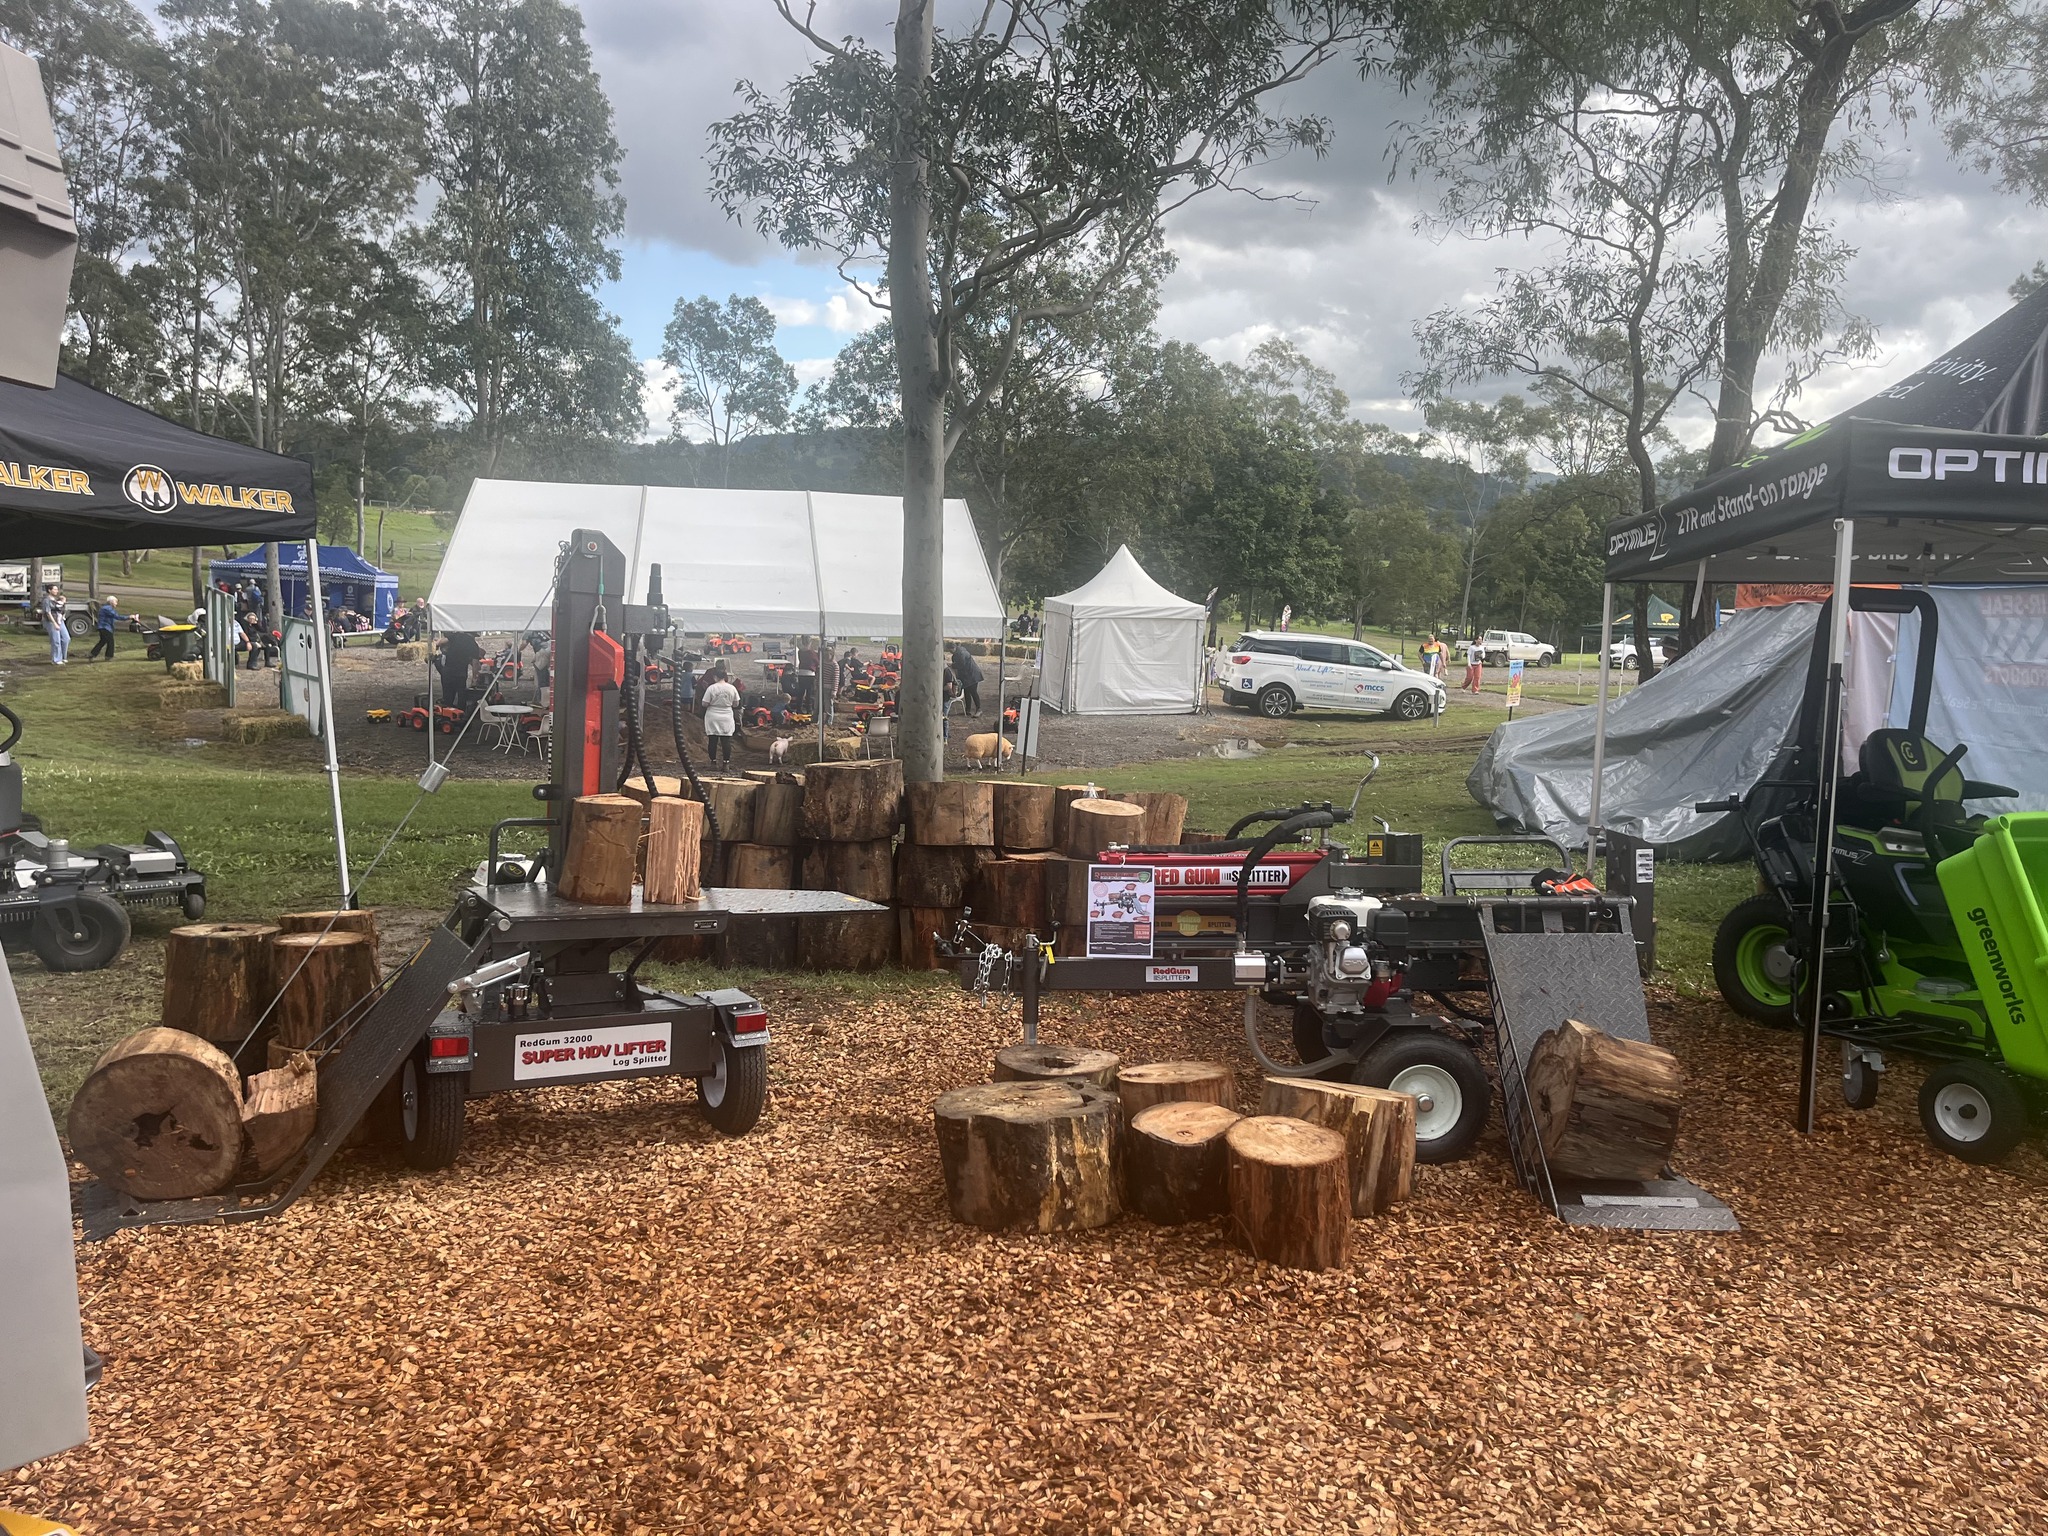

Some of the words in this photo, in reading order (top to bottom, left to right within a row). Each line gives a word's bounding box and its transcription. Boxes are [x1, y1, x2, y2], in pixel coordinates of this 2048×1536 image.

[176, 481, 296, 514] WALKER
[1676, 507, 1699, 535] ZTR
[1700, 505, 1716, 527] and
[1717, 483, 1778, 522] Stand-on
[1779, 462, 1828, 499] range
[1608, 522, 1657, 556] OPTIMUS
[1295, 664, 1313, 672] Need
[1317, 666, 1333, 676] Lift?
[1364, 684, 1385, 692] mccs
[1831, 846, 1859, 859] TIMUS
[1184, 868, 1221, 886] GUM
[1232, 870, 1281, 883] SITTER
[1152, 967, 1191, 975] RedGum
[1967, 907, 2026, 1026] greenworks
[520, 1037, 561, 1048] RedGum
[563, 1034, 593, 1044] 32000
[521, 1047, 576, 1066] SUPER
[578, 1044, 612, 1060] HDV
[614, 1039, 667, 1057] LIFTER
[613, 1058, 630, 1067] Log
[632, 1055, 668, 1066] Splitter
